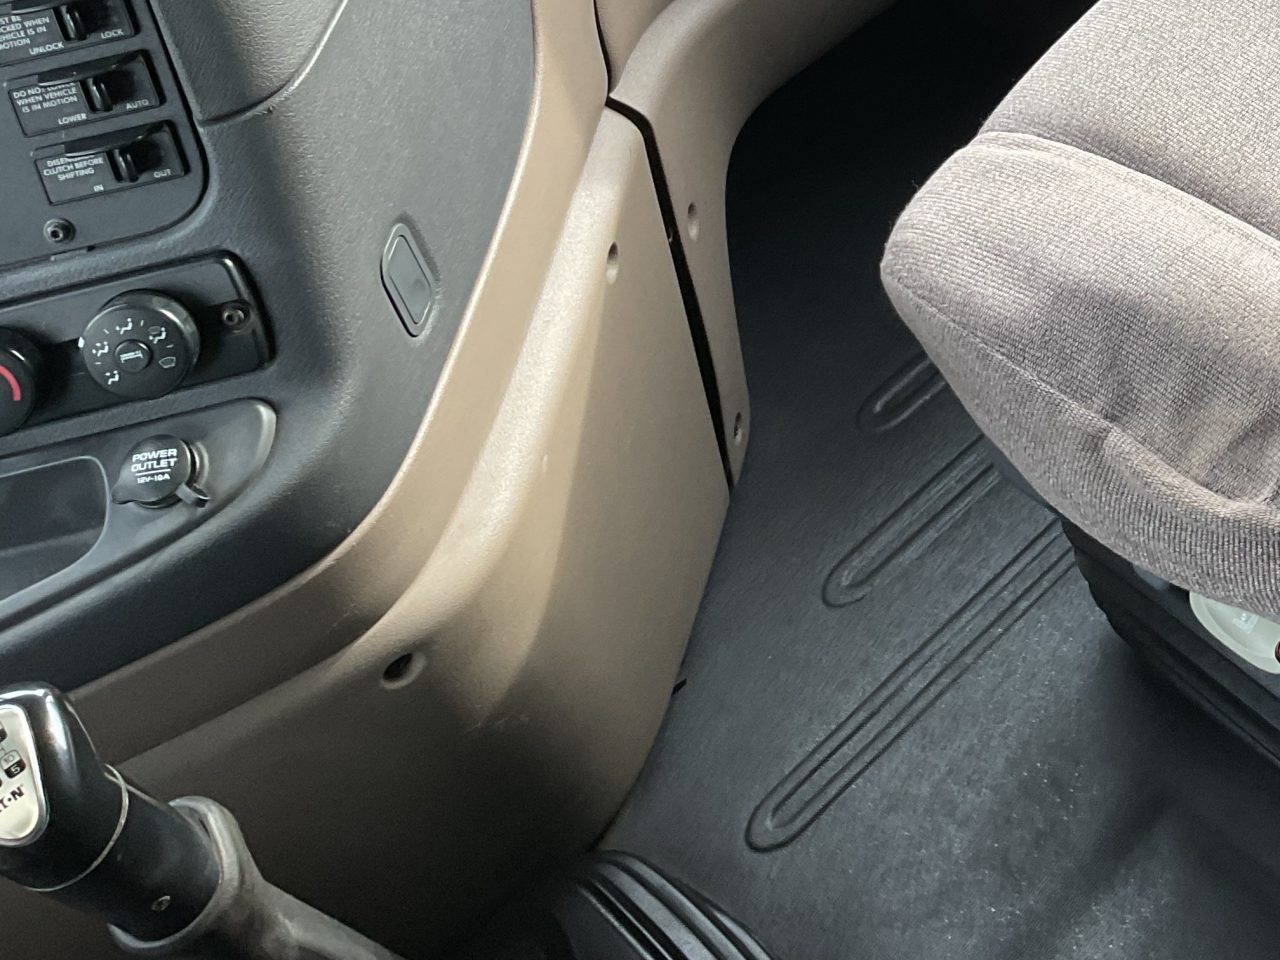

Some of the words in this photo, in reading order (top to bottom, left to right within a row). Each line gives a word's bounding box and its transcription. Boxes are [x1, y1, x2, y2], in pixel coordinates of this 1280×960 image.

[23, 16, 50, 28] WHEN
[27, 28, 36, 36] IS
[36, 25, 47, 34] IN
[100, 29, 124, 39] LOCK
[29, 41, 65, 55] UNLOCK
[13, 90, 27, 99] DO
[16, 95, 43, 106] WHEN
[43, 87, 78, 100] VEHICLE
[31, 103, 42, 111] IN
[42, 95, 78, 109] MOTION
[126, 99, 149, 110] AUTO
[57, 113, 87, 125] LOWER
[43, 164, 75, 176] CLUTCH
[74, 157, 104, 170] BEFORE
[57, 167, 95, 181] SHIFTING
[153, 168, 172, 178] OUT
[93, 184, 105, 192] IN
[132, 448, 178, 463] POWER
[131, 458, 179, 473] OUTLET
[136, 473, 171, 484] 12V-10A
[10, 763, 21, 774] 5
